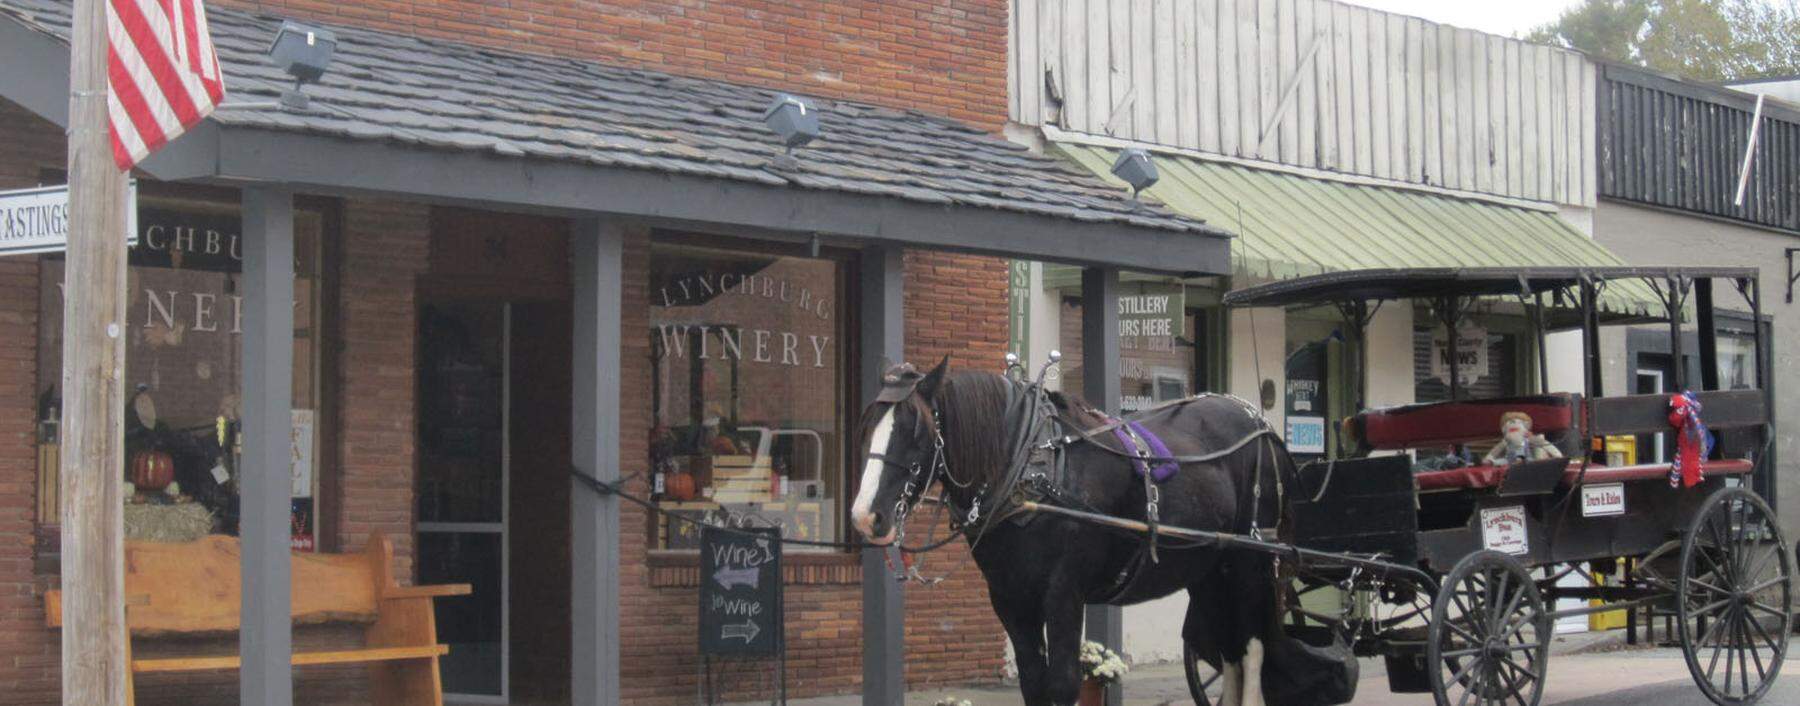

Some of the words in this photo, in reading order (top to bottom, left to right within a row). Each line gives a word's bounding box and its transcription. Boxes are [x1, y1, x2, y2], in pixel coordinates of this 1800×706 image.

[660, 272, 829, 320] LYNCHBURG
[1118, 295, 1169, 315] STILLERY
[1119, 319, 1140, 337] URS
[1142, 318, 1172, 336] HERE
[658, 322, 830, 368] WINERY
[1440, 348, 1478, 366] NWS
[710, 542, 762, 568] Wine
